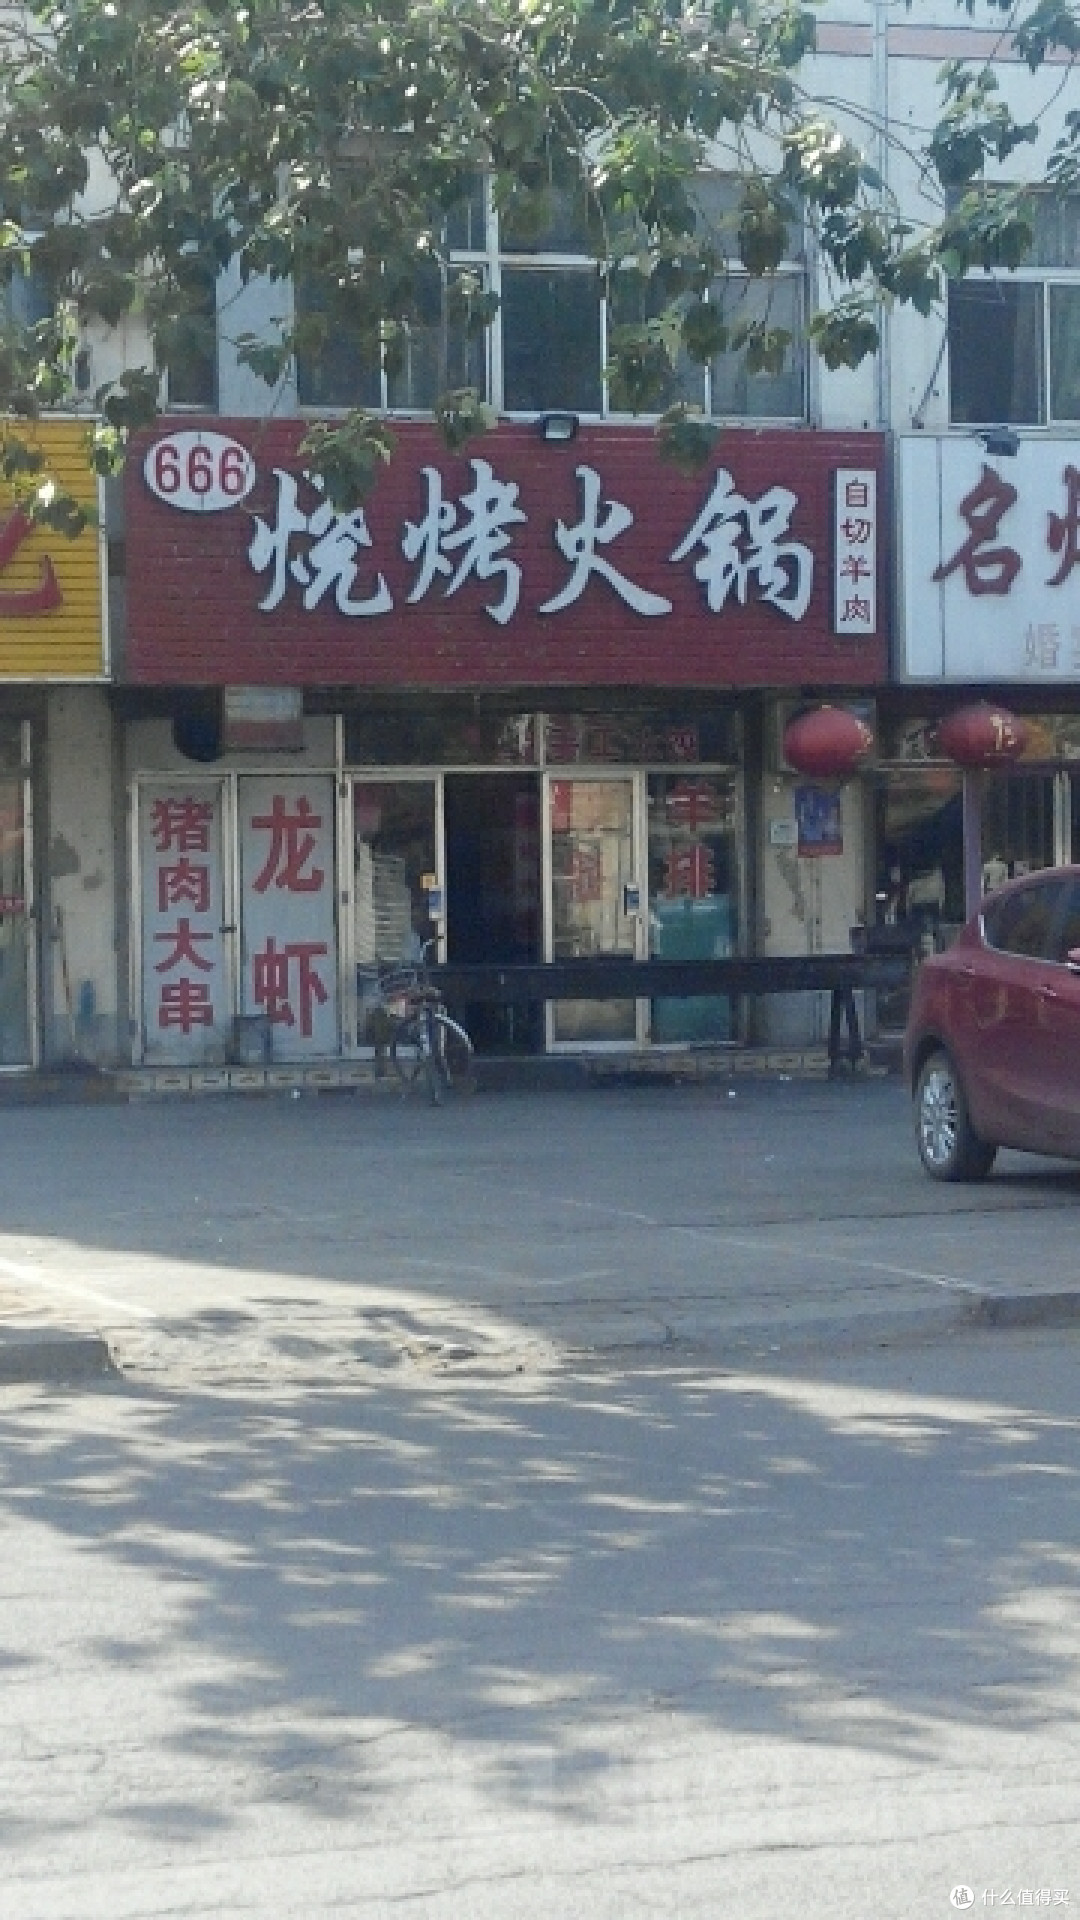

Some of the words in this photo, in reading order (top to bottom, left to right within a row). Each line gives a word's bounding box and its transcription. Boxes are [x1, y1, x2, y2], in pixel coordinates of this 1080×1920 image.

[154, 445, 247, 495] 666
[248, 458, 814, 625] 烧烤火锅
[839, 477, 872, 624] 自切羊肉
[150, 797, 215, 1035] 猪肉大串
[251, 794, 328, 1038] 龙虾
